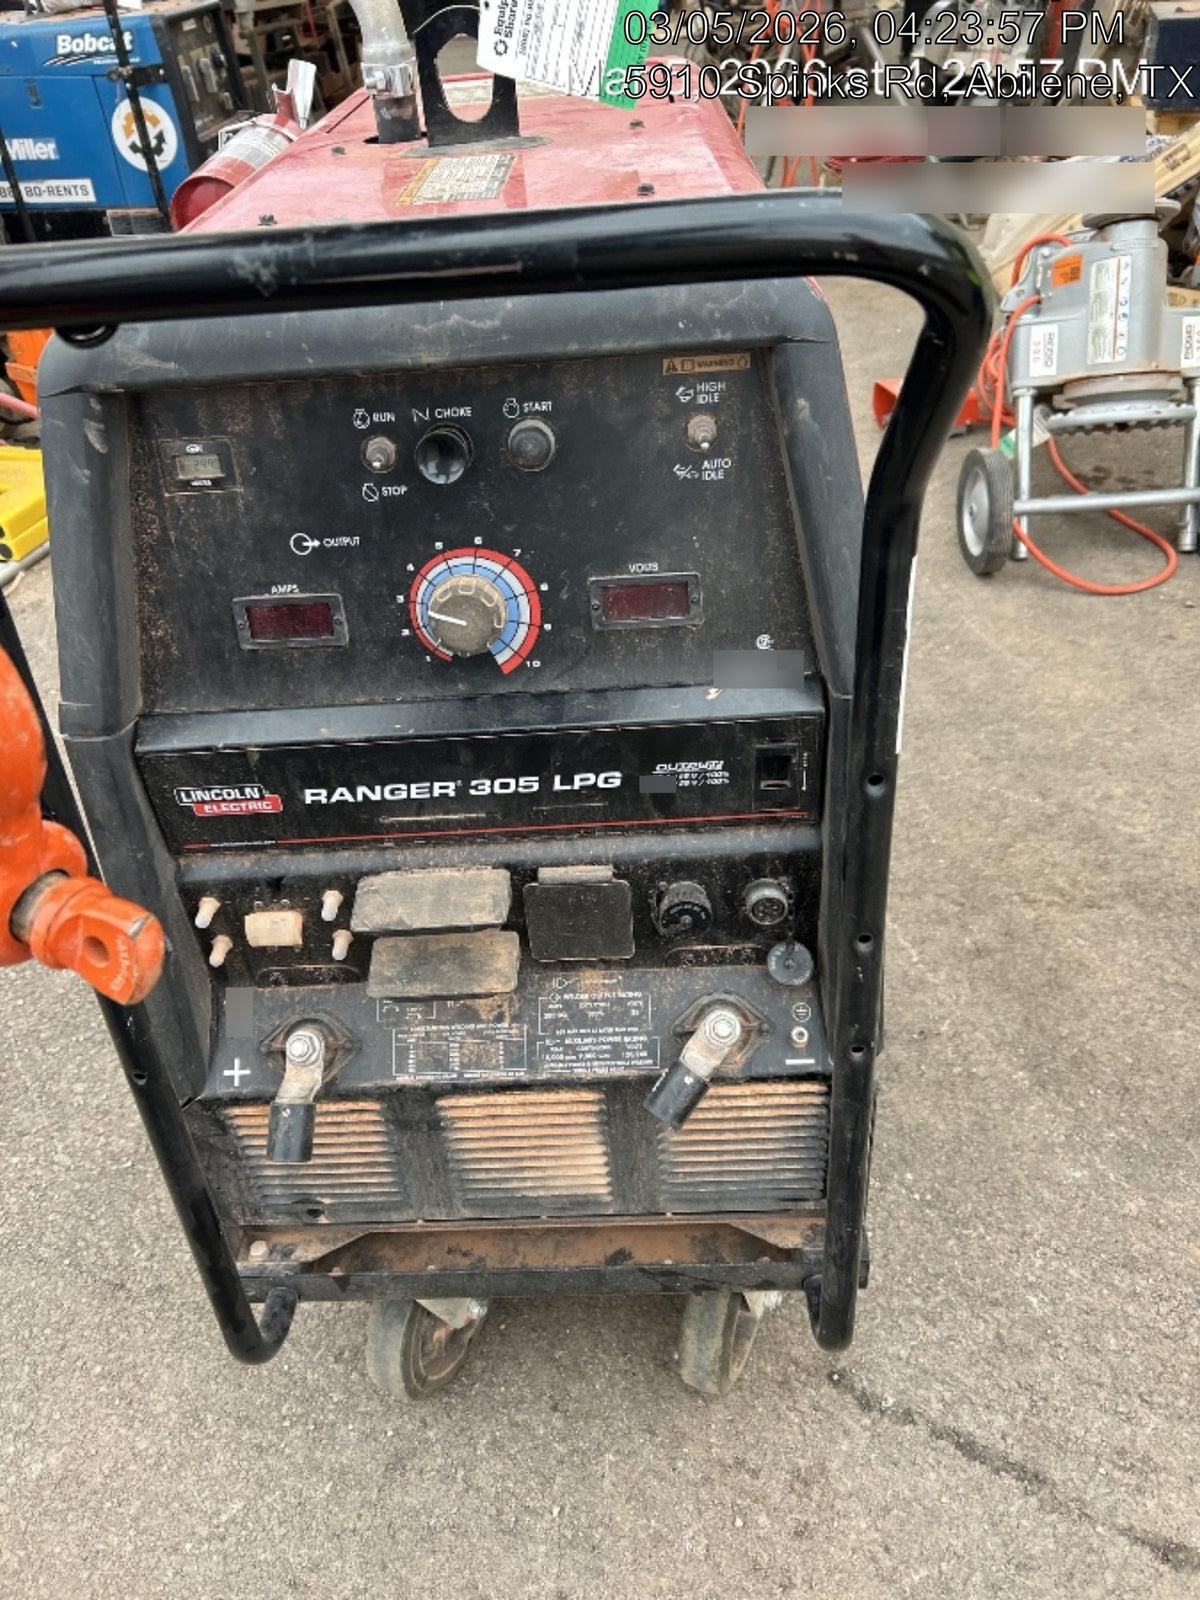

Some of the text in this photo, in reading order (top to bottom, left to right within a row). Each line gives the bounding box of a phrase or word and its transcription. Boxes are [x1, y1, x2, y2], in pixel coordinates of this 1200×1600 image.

[696, 382, 726, 392] HIGH
[696, 393, 720, 404] IDLE
[434, 407, 472, 419] CHOKE
[523, 401, 552, 413] START
[372, 411, 396, 423] RUN
[701, 458, 732, 470] AUTO
[701, 470, 725, 481] IDLE
[381, 485, 408, 497] STOP
[323, 536, 360, 548] OUTPUT
[473, 536, 483, 545] 6
[513, 548, 522, 557] 7
[628, 561, 659, 573] VOLTS
[271, 584, 299, 594] AMPS
[525, 659, 542, 669] 10
[468, 776, 540, 796] 305
[552, 771, 623, 792] LPG
[180, 786, 260, 802] LINCOLN
[203, 801, 273, 814] ELECTRIC
